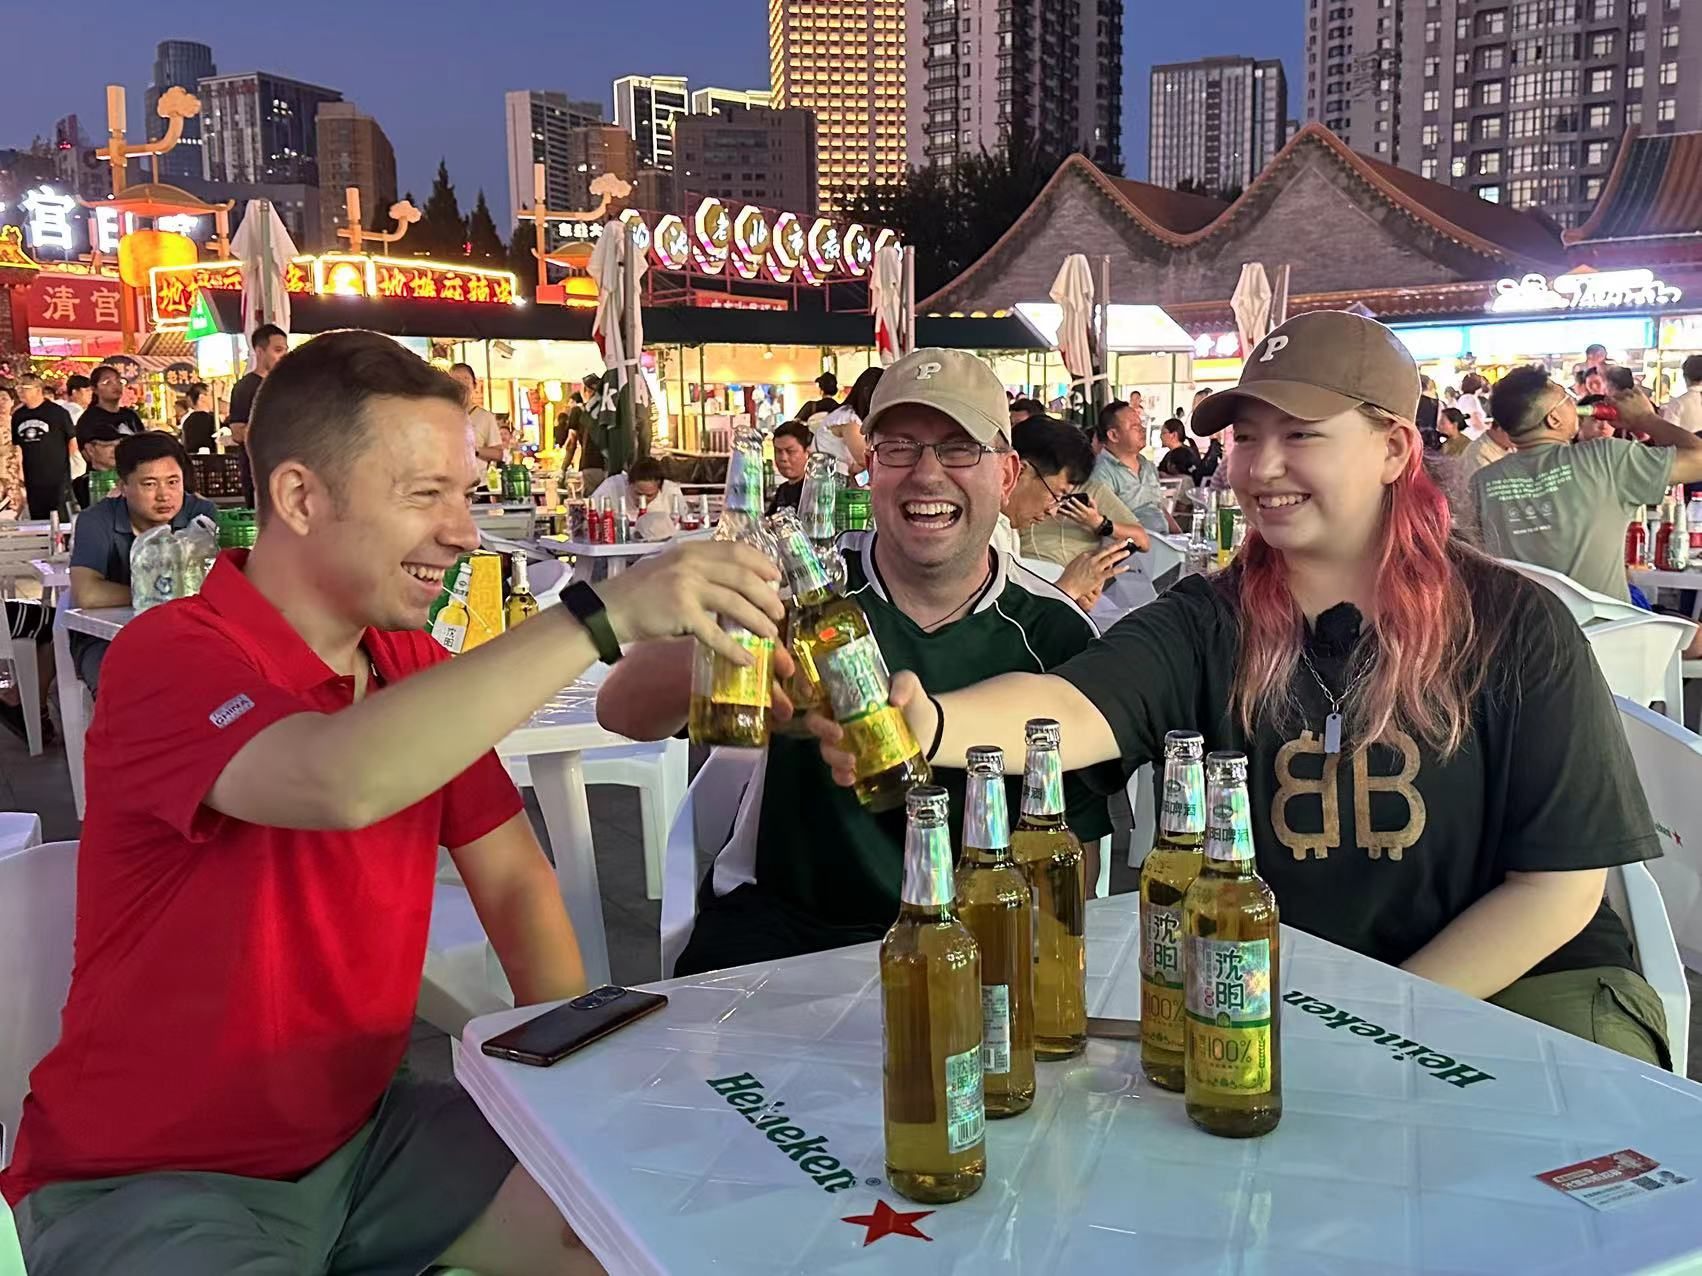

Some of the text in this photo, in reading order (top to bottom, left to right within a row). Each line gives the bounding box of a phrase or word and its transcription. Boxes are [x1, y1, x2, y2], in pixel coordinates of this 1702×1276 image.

[42, 285, 121, 323] 清宫
[1260, 336, 1288, 362] P
[917, 362, 941, 379] P
[215, 699, 250, 725] CHINA
[1215, 947, 1245, 1010] 沈阳
[1208, 1035, 1253, 1063] 100%
[1282, 990, 1496, 1088] Heineken
[706, 1072, 858, 1194] Heineken
